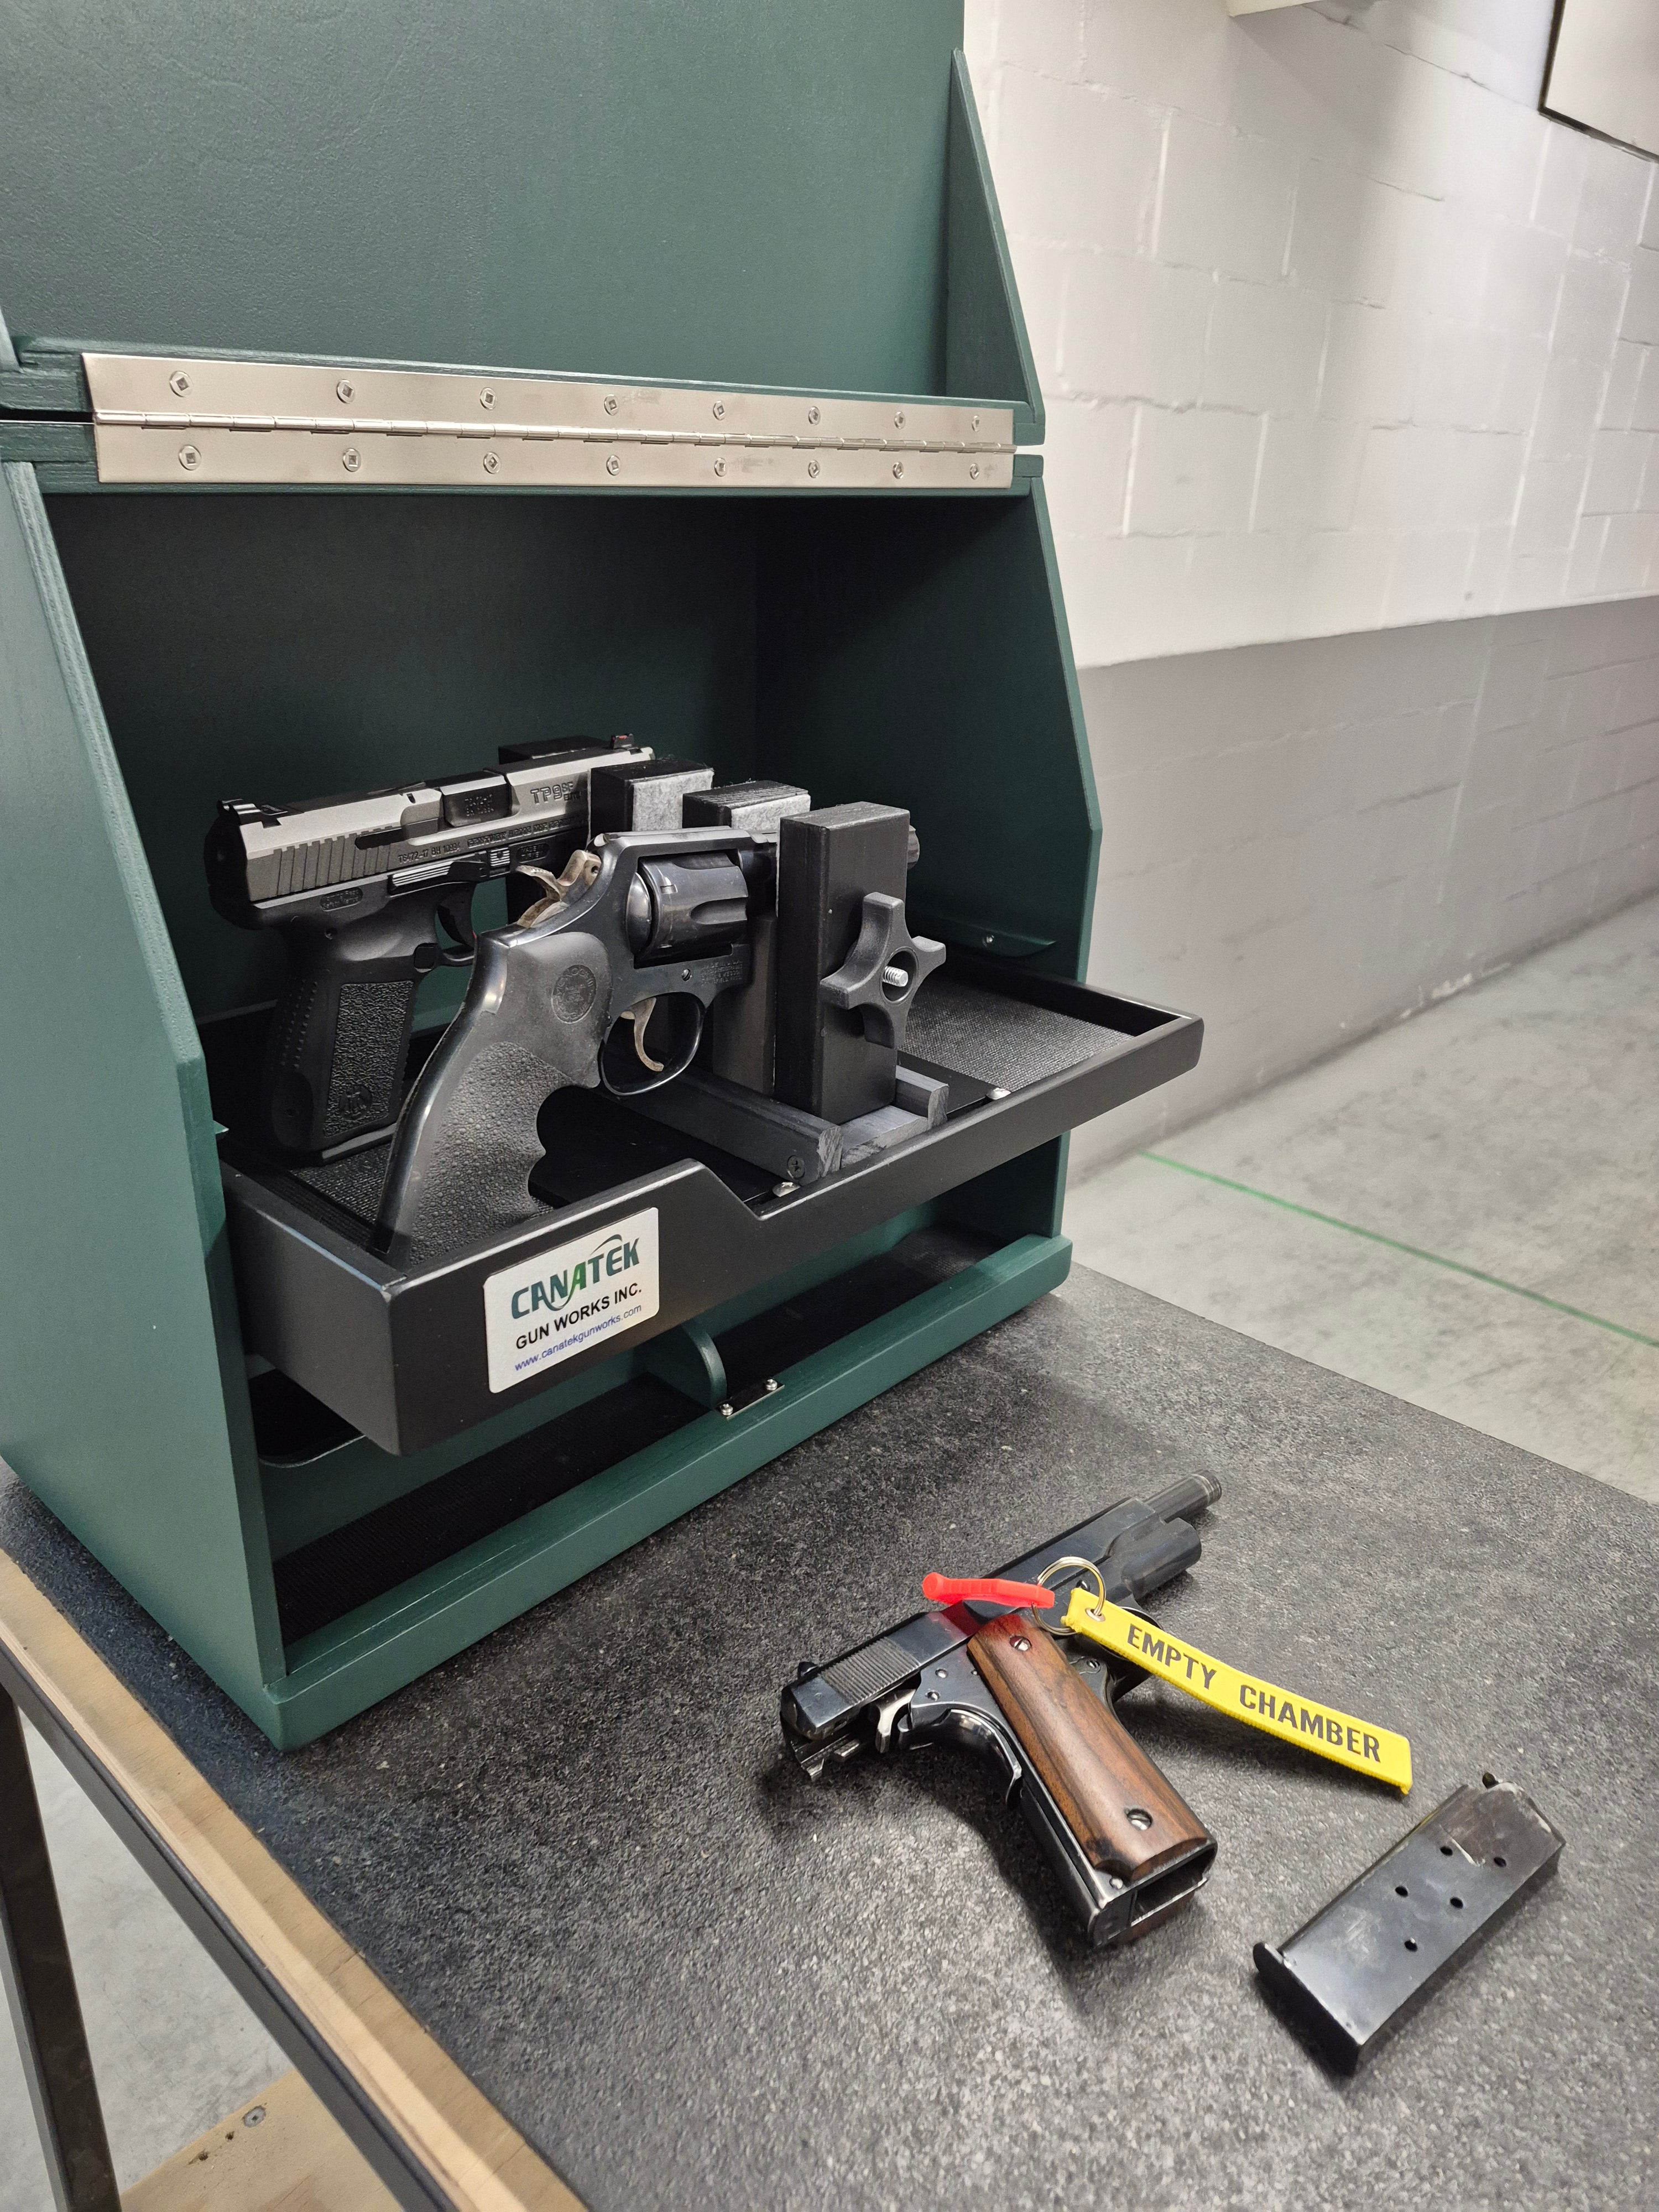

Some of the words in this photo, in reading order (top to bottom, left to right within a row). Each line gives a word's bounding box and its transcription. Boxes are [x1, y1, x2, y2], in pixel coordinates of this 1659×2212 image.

[511, 1234, 640, 1319] CANATEK
[514, 1305, 642, 1371] www.canatekgunworks.com
[515, 1323, 550, 1350] GUN
[554, 1296, 610, 1333] WORKS
[614, 1282, 642, 1304] INC.
[1127, 1624, 1217, 1691] EMPTY
[1239, 1683, 1381, 1764] CHAMBER
